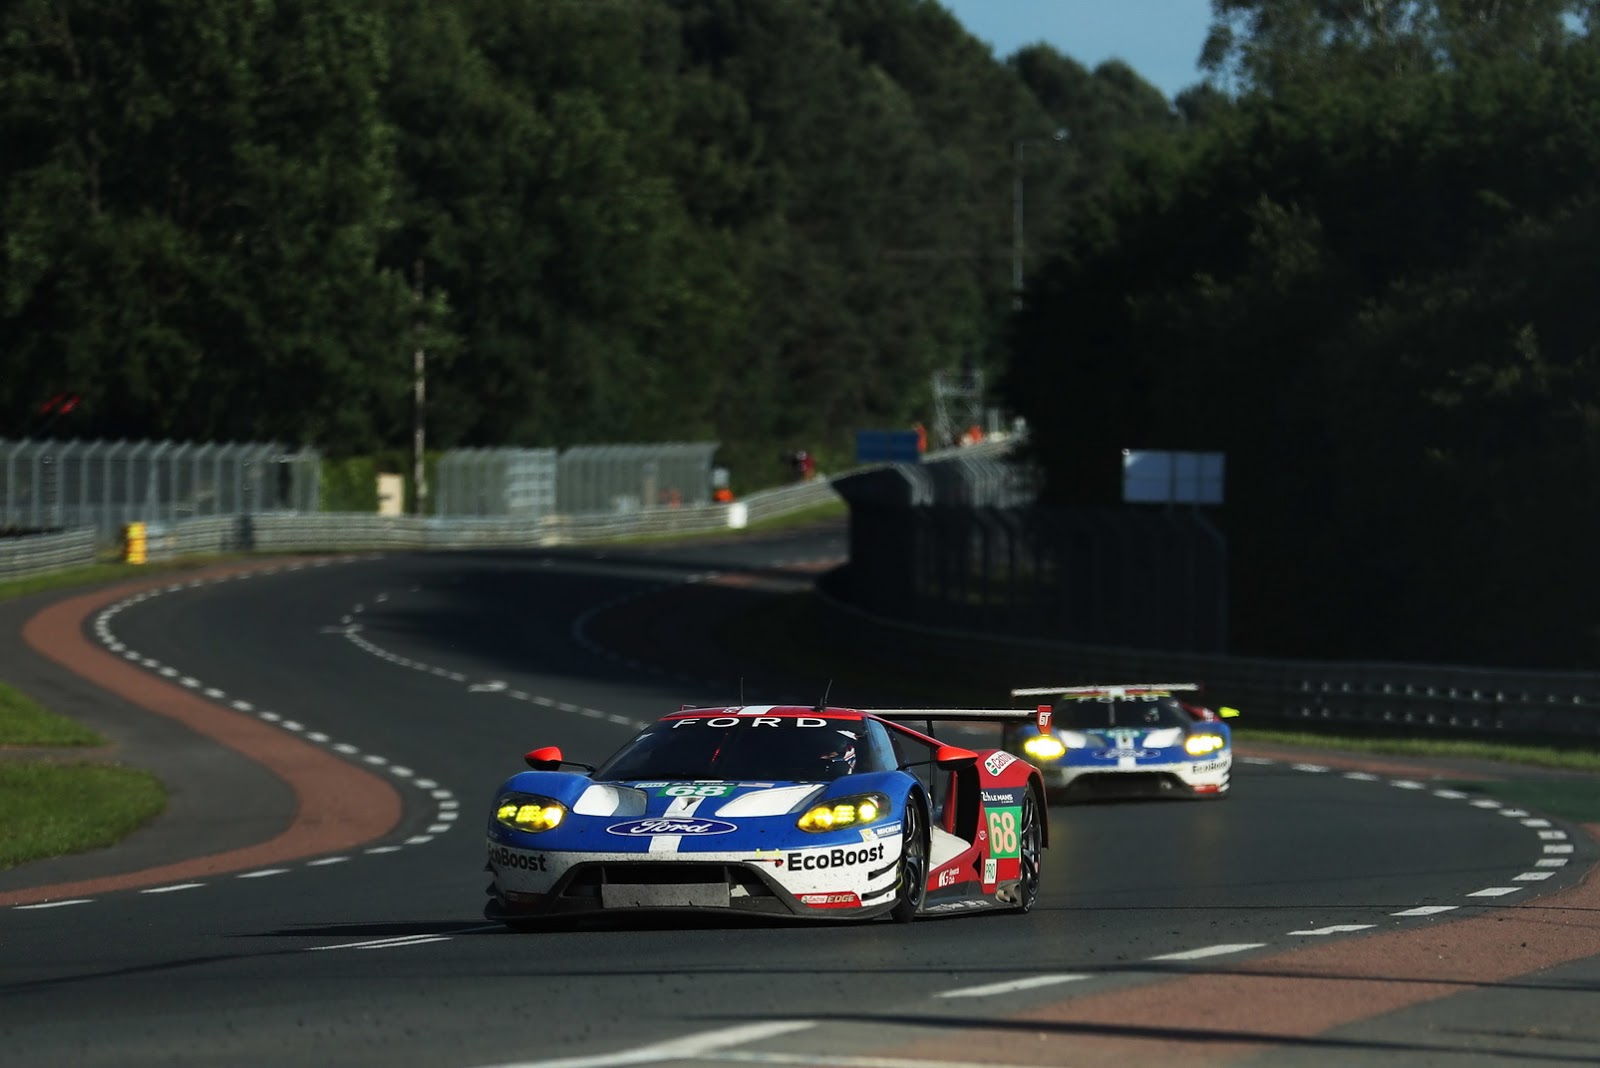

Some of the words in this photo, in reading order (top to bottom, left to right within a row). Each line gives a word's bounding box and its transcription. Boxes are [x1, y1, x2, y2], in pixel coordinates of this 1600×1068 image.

[672, 717, 827, 728] FORD
[1038, 712, 1052, 727] GT
[665, 785, 727, 796] 68
[630, 819, 713, 834] Ford
[989, 811, 1017, 854] 68
[787, 842, 884, 872] EcoBoost
[985, 862, 996, 881] PRO
[827, 894, 855, 903] EDGE
